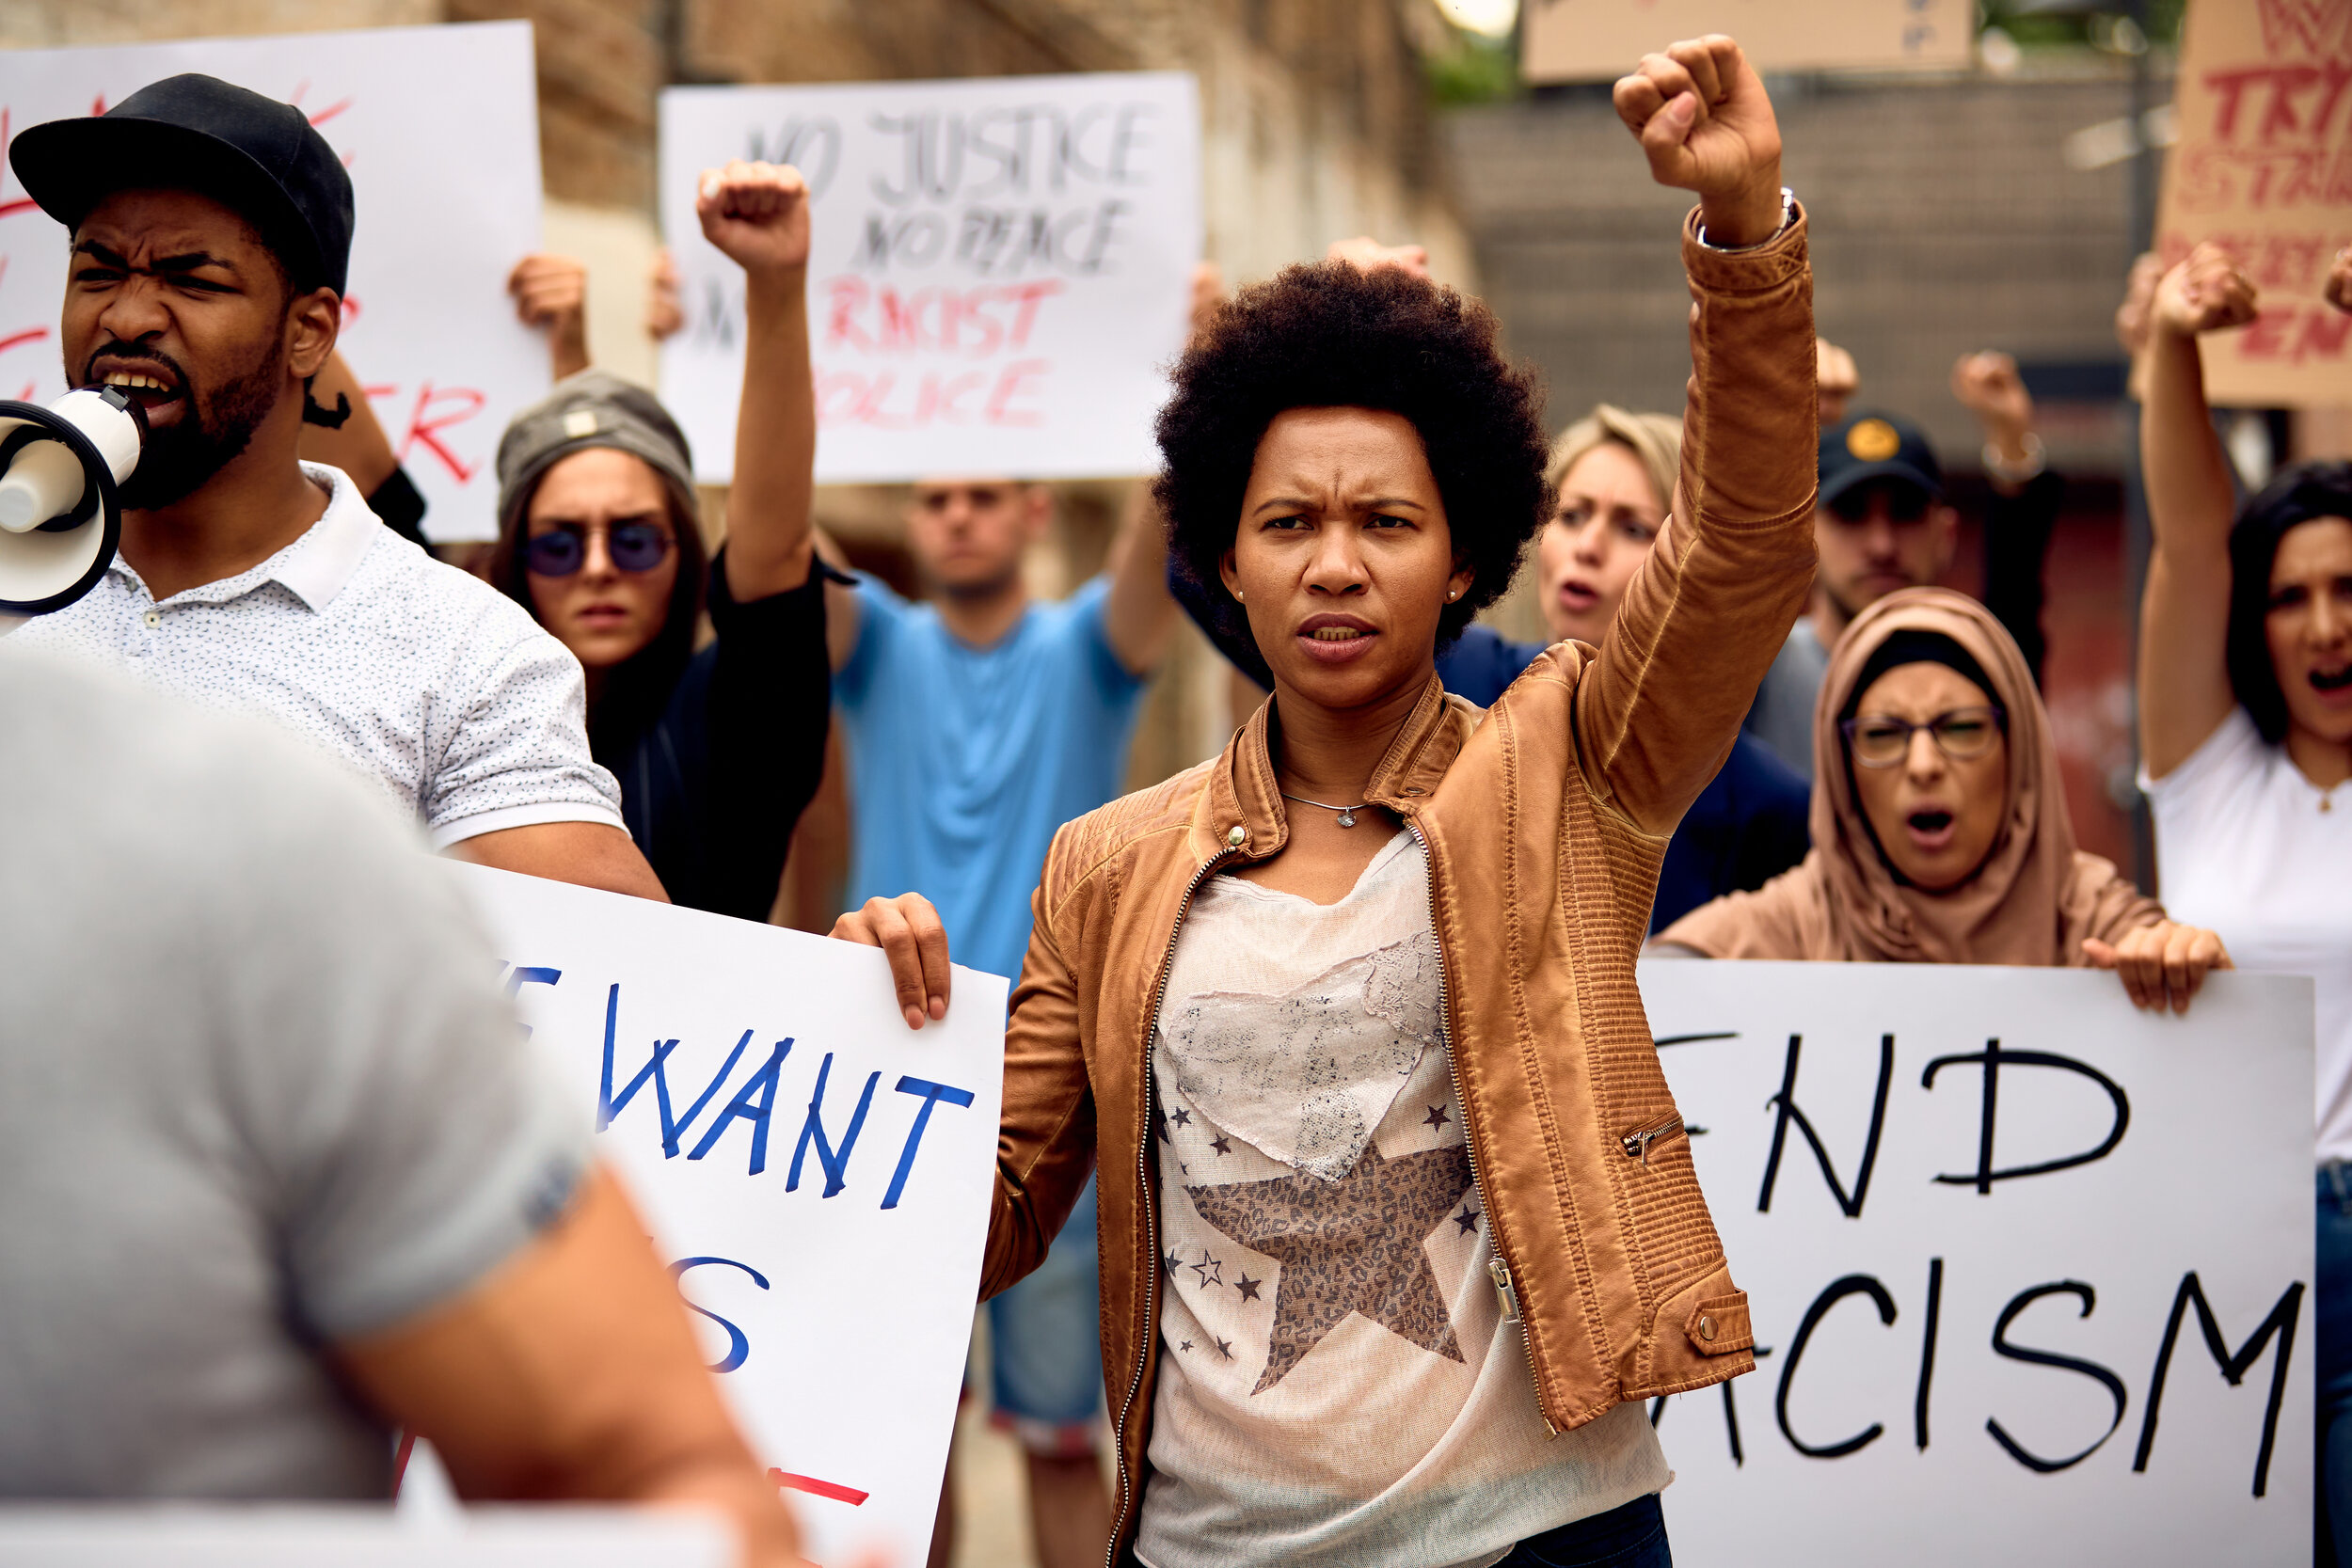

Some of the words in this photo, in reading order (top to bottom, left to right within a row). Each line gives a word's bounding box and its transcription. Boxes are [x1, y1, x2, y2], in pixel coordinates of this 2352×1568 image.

[866, 100, 1163, 207] JUSTICE
[851, 208, 946, 276] NO
[952, 198, 1132, 277] PEACE
[693, 276, 747, 352] N
[824, 274, 1068, 357] RACIST
[813, 357, 1054, 430] OLICE
[596, 982, 975, 1211] WANT
[664, 1256, 770, 1374] S
